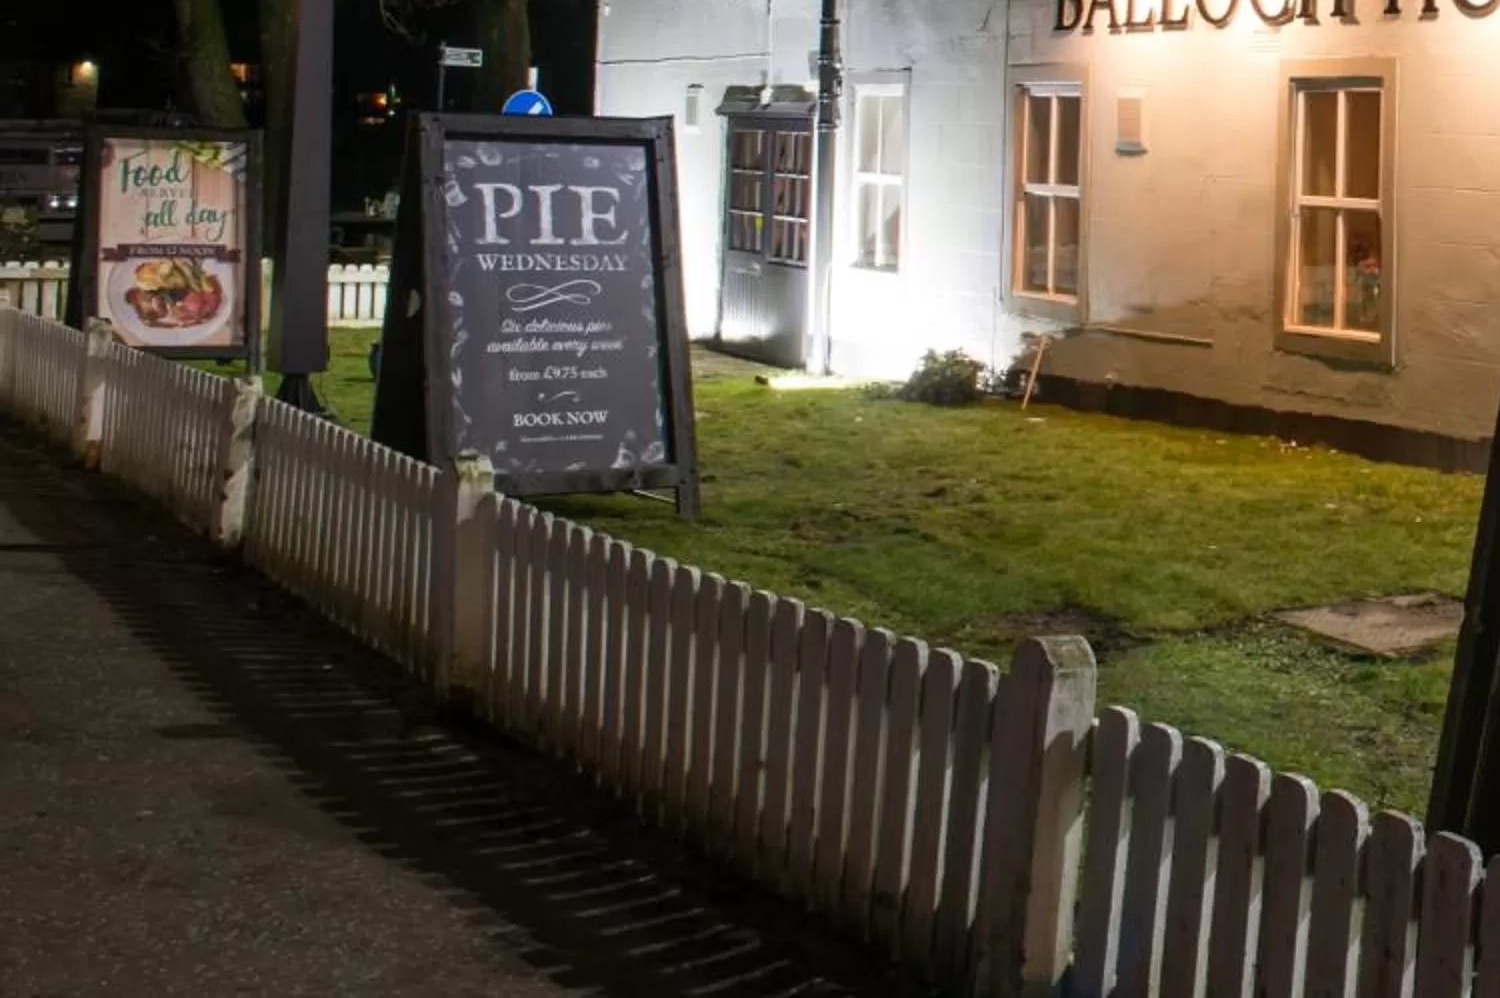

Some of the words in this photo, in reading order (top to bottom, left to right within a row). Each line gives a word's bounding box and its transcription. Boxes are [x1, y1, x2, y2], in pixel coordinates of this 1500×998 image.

[119, 149, 191, 193] Food
[141, 199, 179, 228] all
[185, 202, 231, 242] day
[472, 182, 630, 248] PIE
[476, 253, 629, 273] WEDNESDAY
[513, 412, 564, 426] BOOK
[566, 410, 608, 425] NOW
